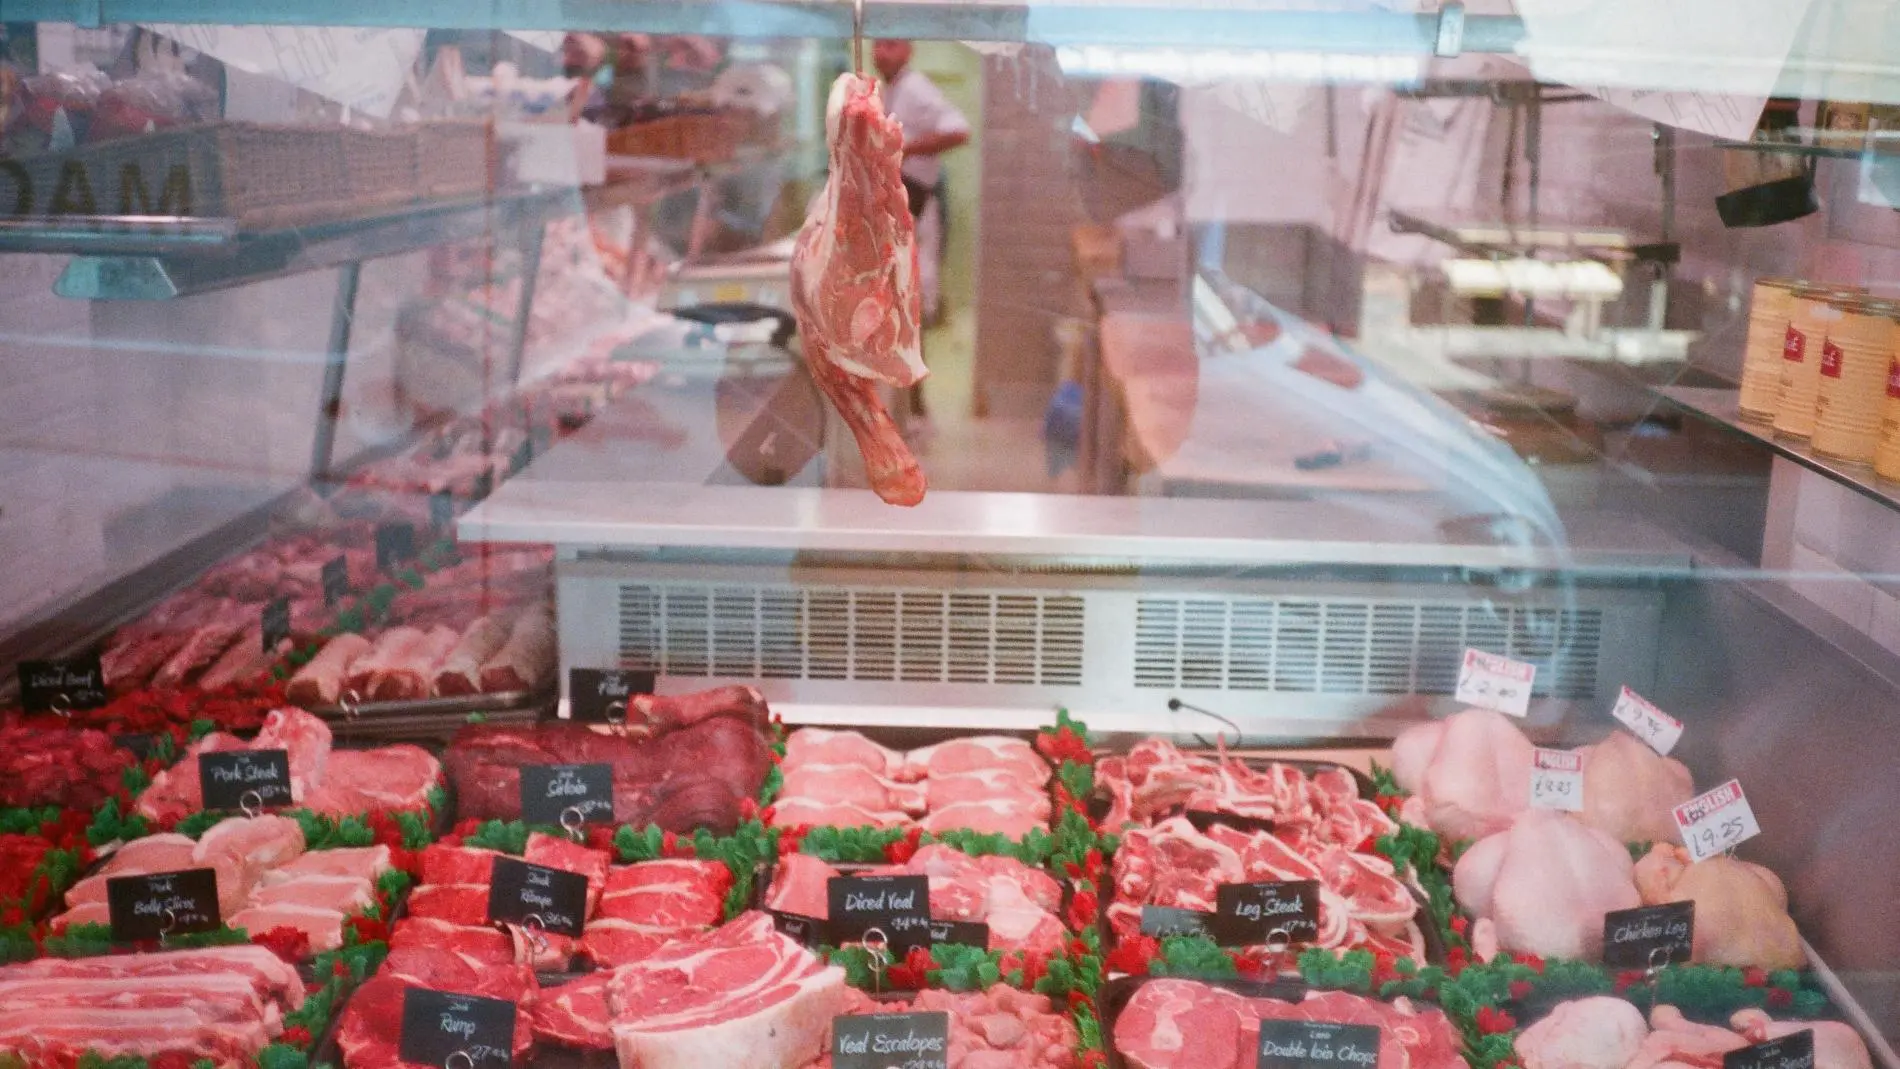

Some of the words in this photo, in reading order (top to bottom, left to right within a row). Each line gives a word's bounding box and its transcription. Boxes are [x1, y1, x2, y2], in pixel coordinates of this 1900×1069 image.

[211, 763, 242, 782] Pork
[845, 889, 885, 911] Diced
[887, 888, 916, 911] Veal
[1235, 899, 1261, 921] Leg
[1263, 893, 1304, 917] Steak
[1614, 920, 1663, 943] Chicken
[1664, 919, 1688, 940] Leg
[440, 1012, 476, 1041] Rump
[839, 1030, 869, 1055] Veal
[1263, 1040, 1307, 1058] Double
[1337, 1043, 1377, 1067] Chops
